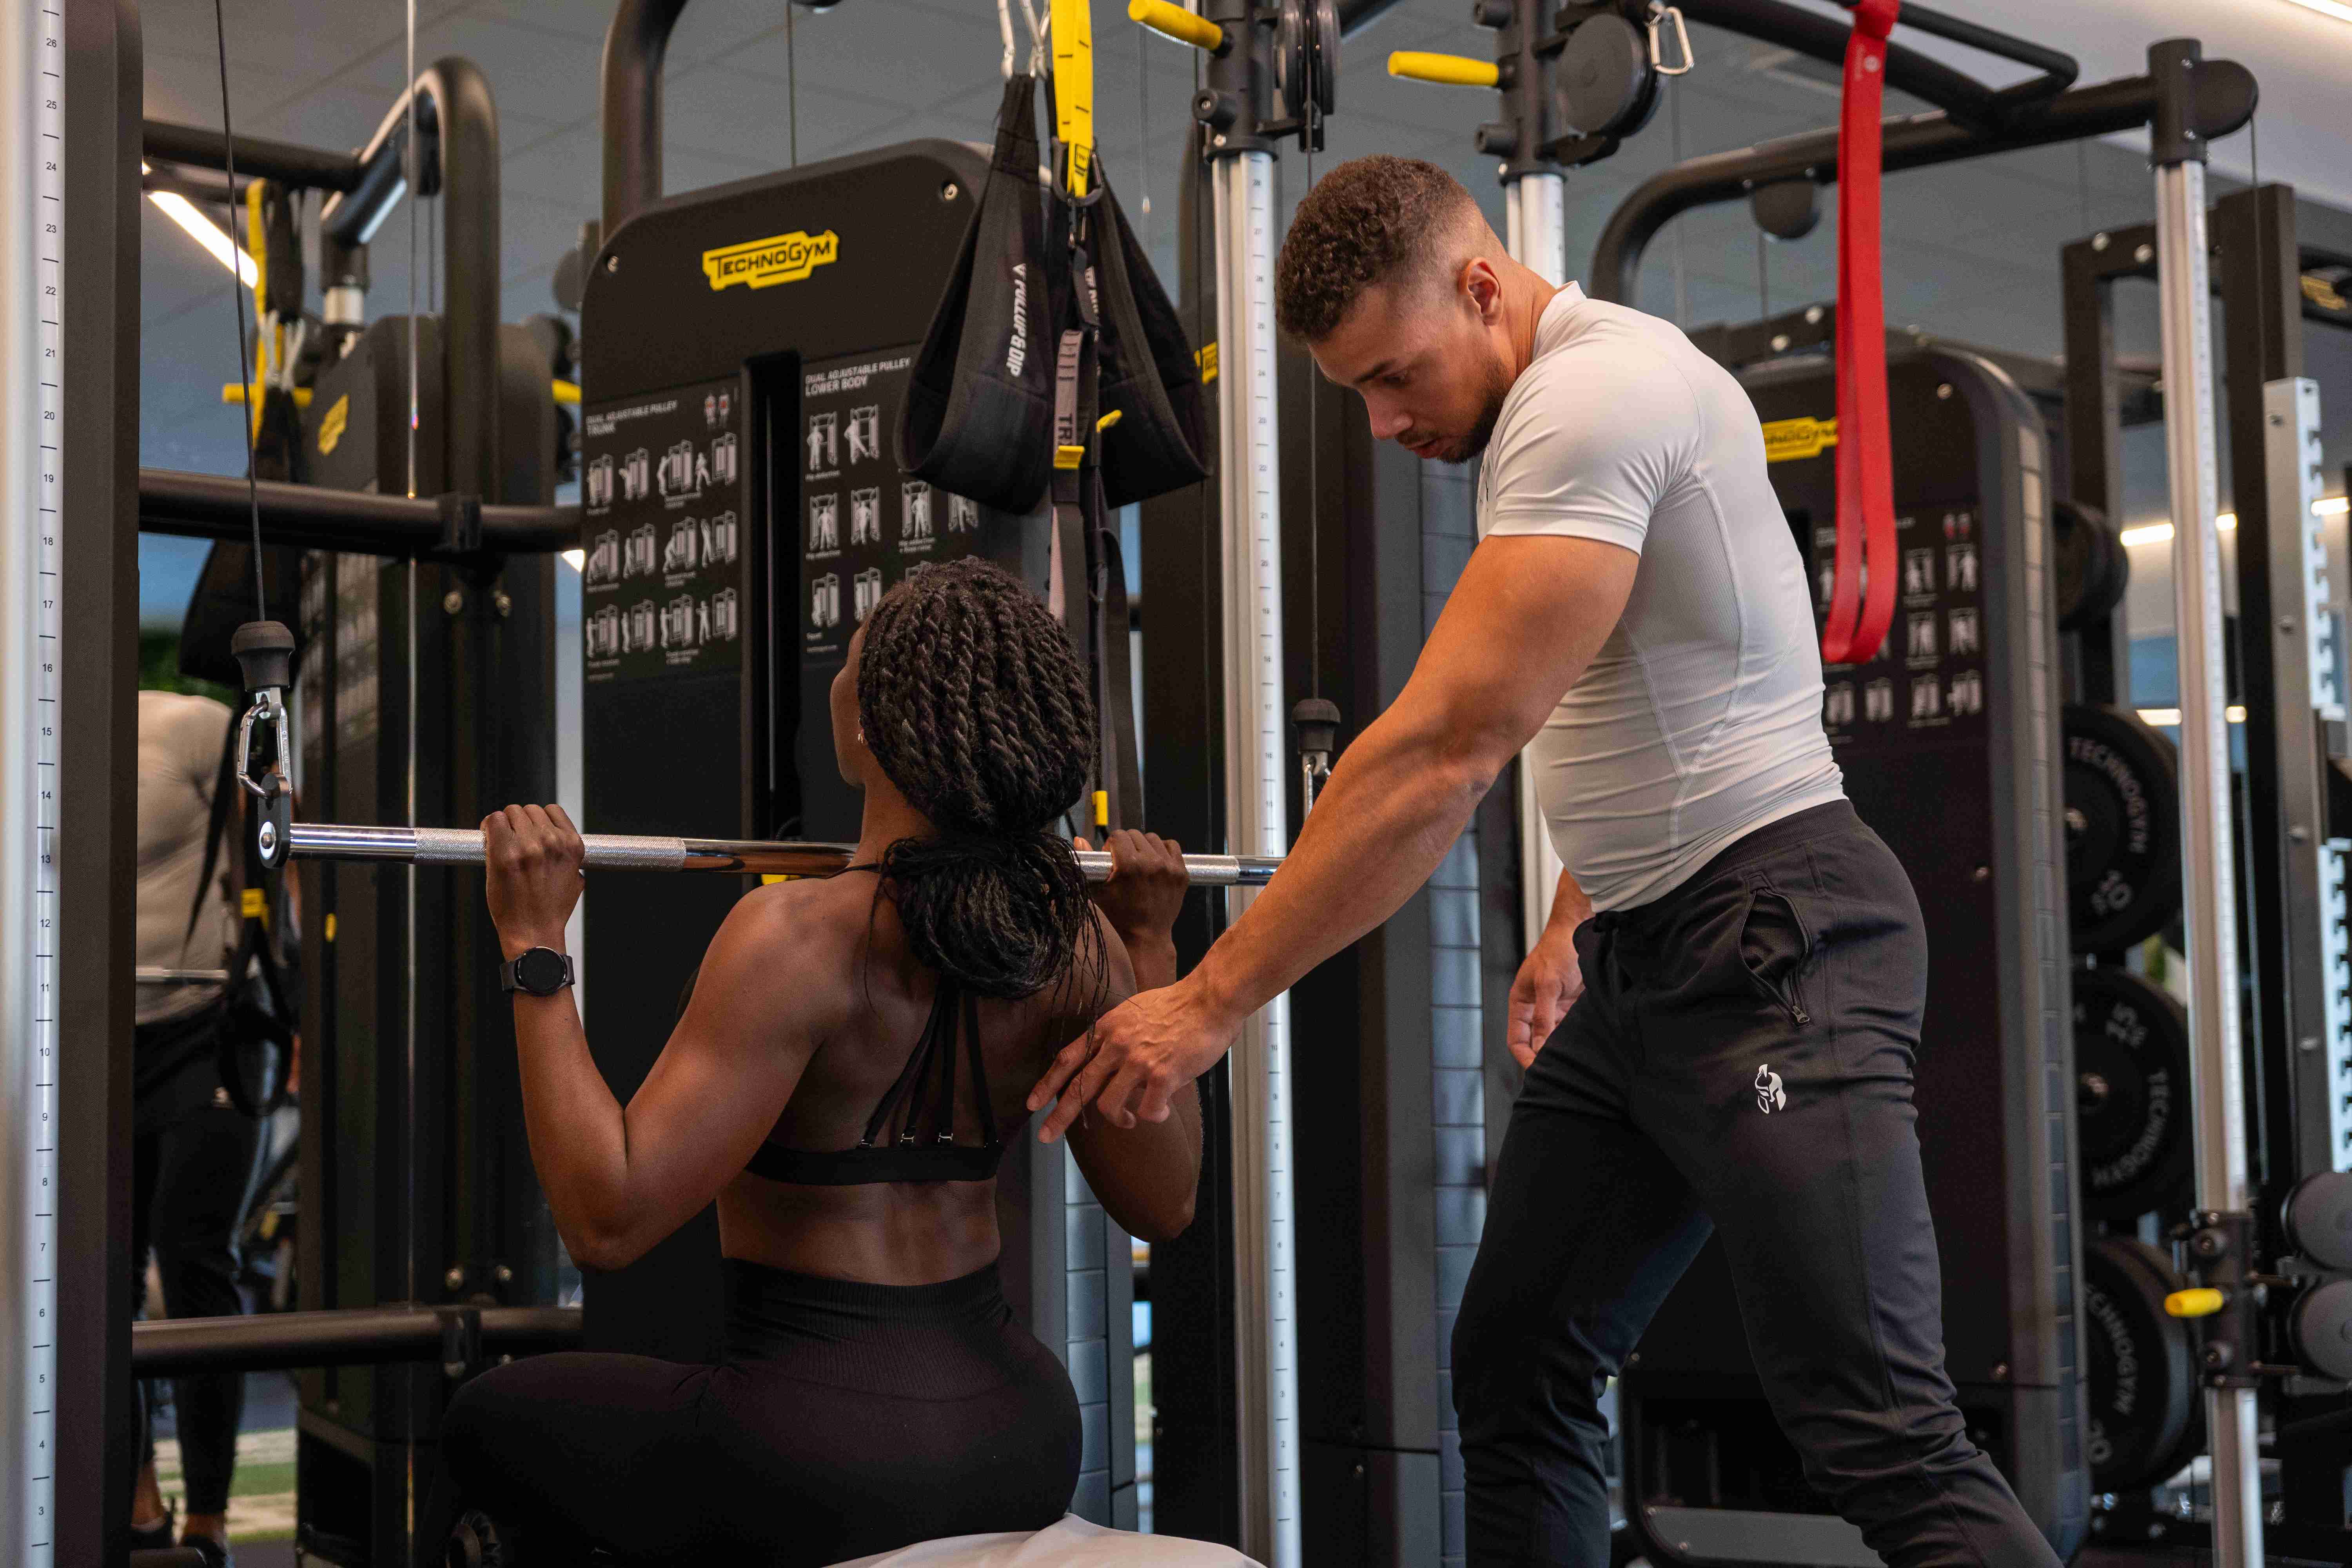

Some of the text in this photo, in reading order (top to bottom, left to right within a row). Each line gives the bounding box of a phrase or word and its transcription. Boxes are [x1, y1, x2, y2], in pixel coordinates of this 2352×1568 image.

[46, 38, 57, 48] 26
[46, 100, 57, 110] 25
[46, 162, 56, 171] 24
[46, 223, 56, 233] 23
[45, 286, 56, 296] 22
[45, 348, 55, 358] 21
[827, 363, 878, 380] ADJUSTABLE
[879, 357, 911, 371] PULLEY
[805, 375, 868, 397] LOWER BODY
[44, 410, 55, 420] 20
[44, 474, 54, 483] 19
[43, 537, 53, 546] 18
[43, 600, 53, 609] 17
[43, 663, 53, 672] 16
[42, 727, 52, 736] 15
[41, 791, 51, 799] 14
[41, 854, 51, 864] 13
[40, 919, 50, 927] 12
[41, 983, 49, 992] 11
[40, 1047, 50, 1056] 10
[42, 1112, 48, 1122] 9
[42, 1177, 48, 1186] 8
[40, 1243, 46, 1252] 7
[39, 1308, 45, 1318] 6
[39, 1374, 45, 1383] 5
[39, 1440, 45, 1449] 4
[38, 1506, 44, 1515] 3
